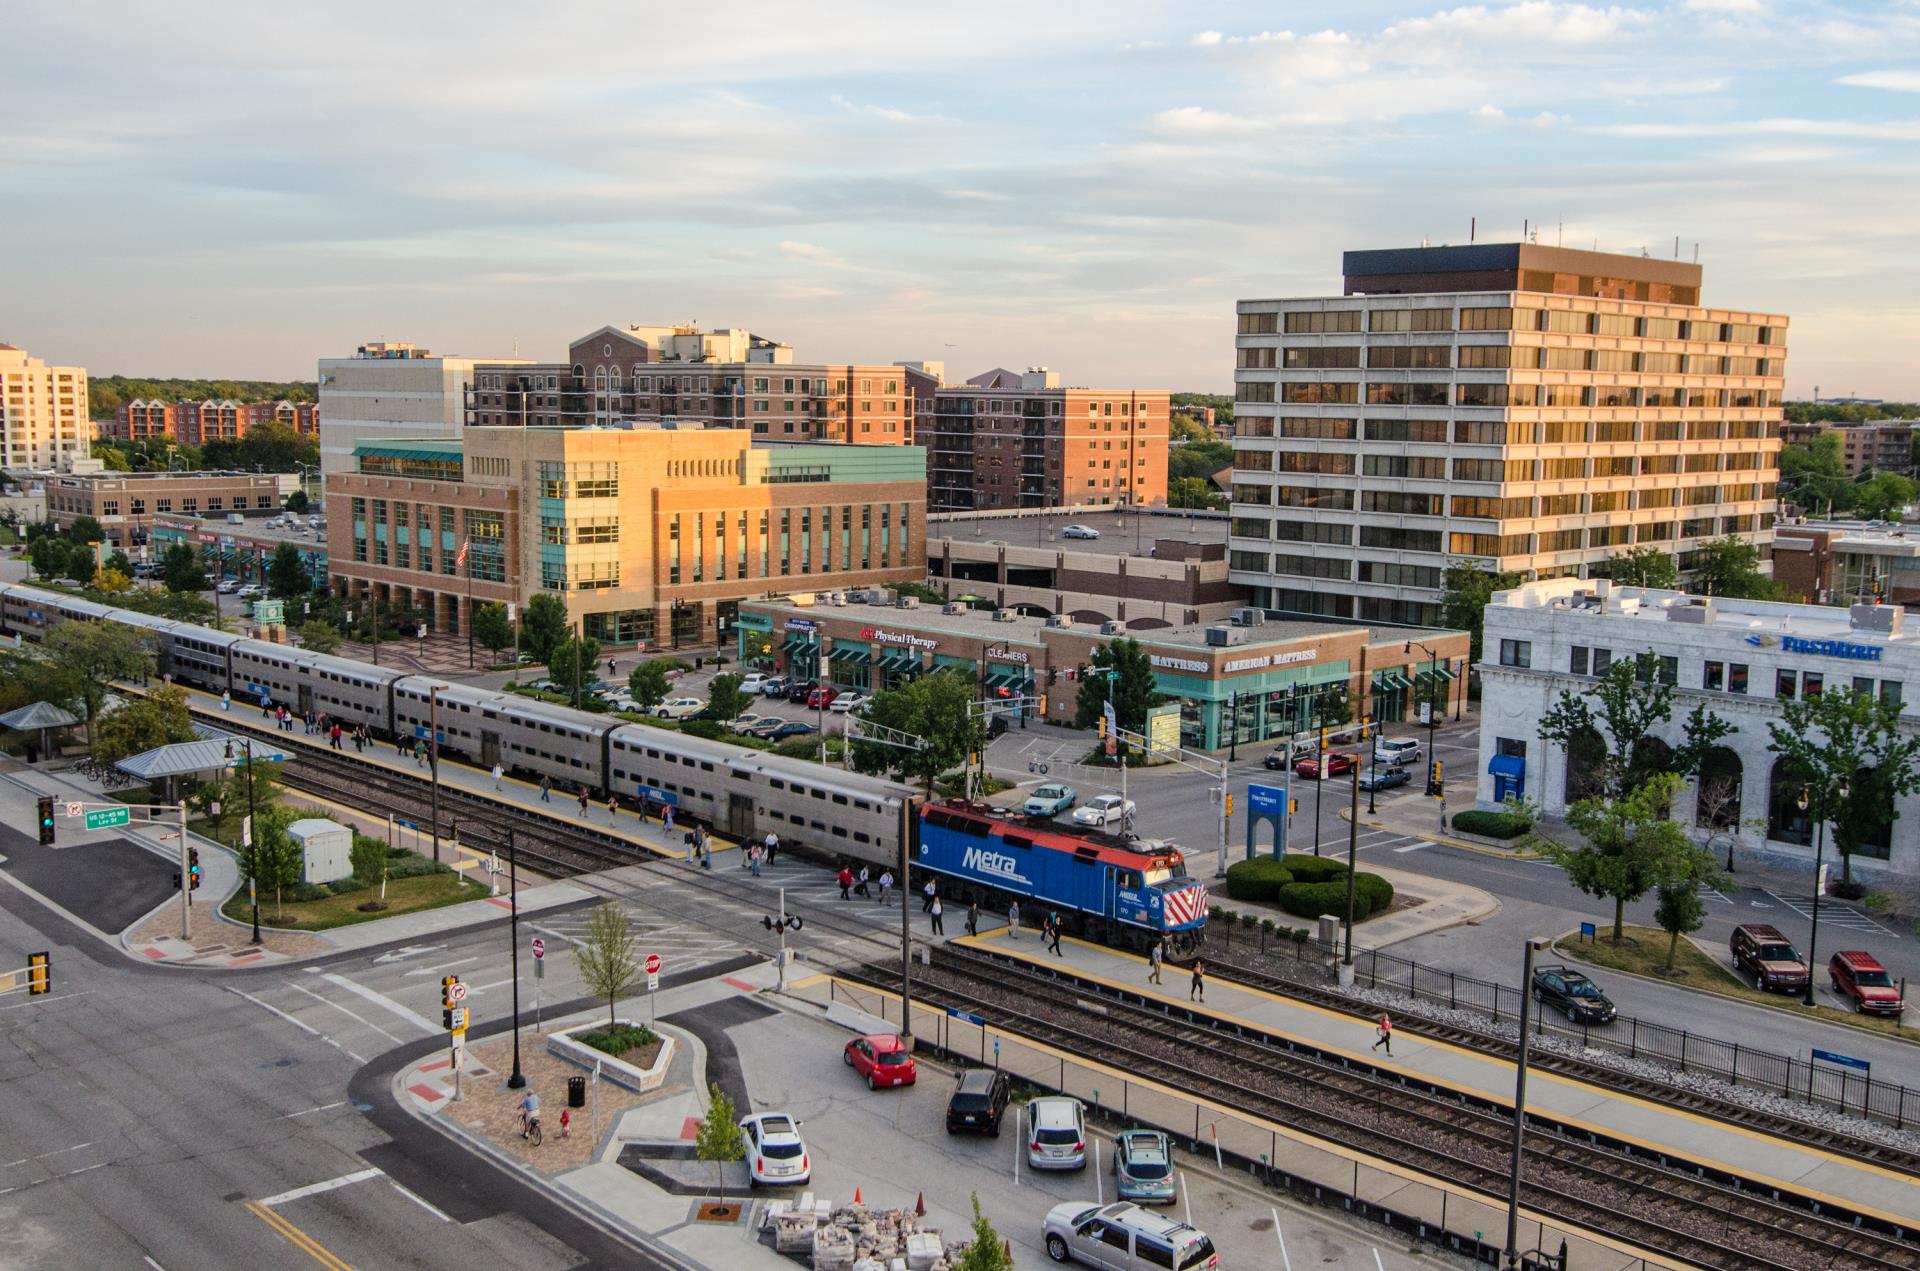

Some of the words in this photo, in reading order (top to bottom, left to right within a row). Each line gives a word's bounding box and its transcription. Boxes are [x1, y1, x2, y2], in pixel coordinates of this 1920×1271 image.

[875, 630, 905, 644] Physical
[905, 634, 938, 650] Therapy
[1782, 636, 1883, 661] FIRSTMERIT
[1150, 655, 1209, 673] MATTRESS
[1223, 655, 1271, 672] AMERICAN
[1273, 649, 1317, 664] MATTRESS
[962, 846, 1016, 874] Metra
[645, 959, 661, 969] STOP
